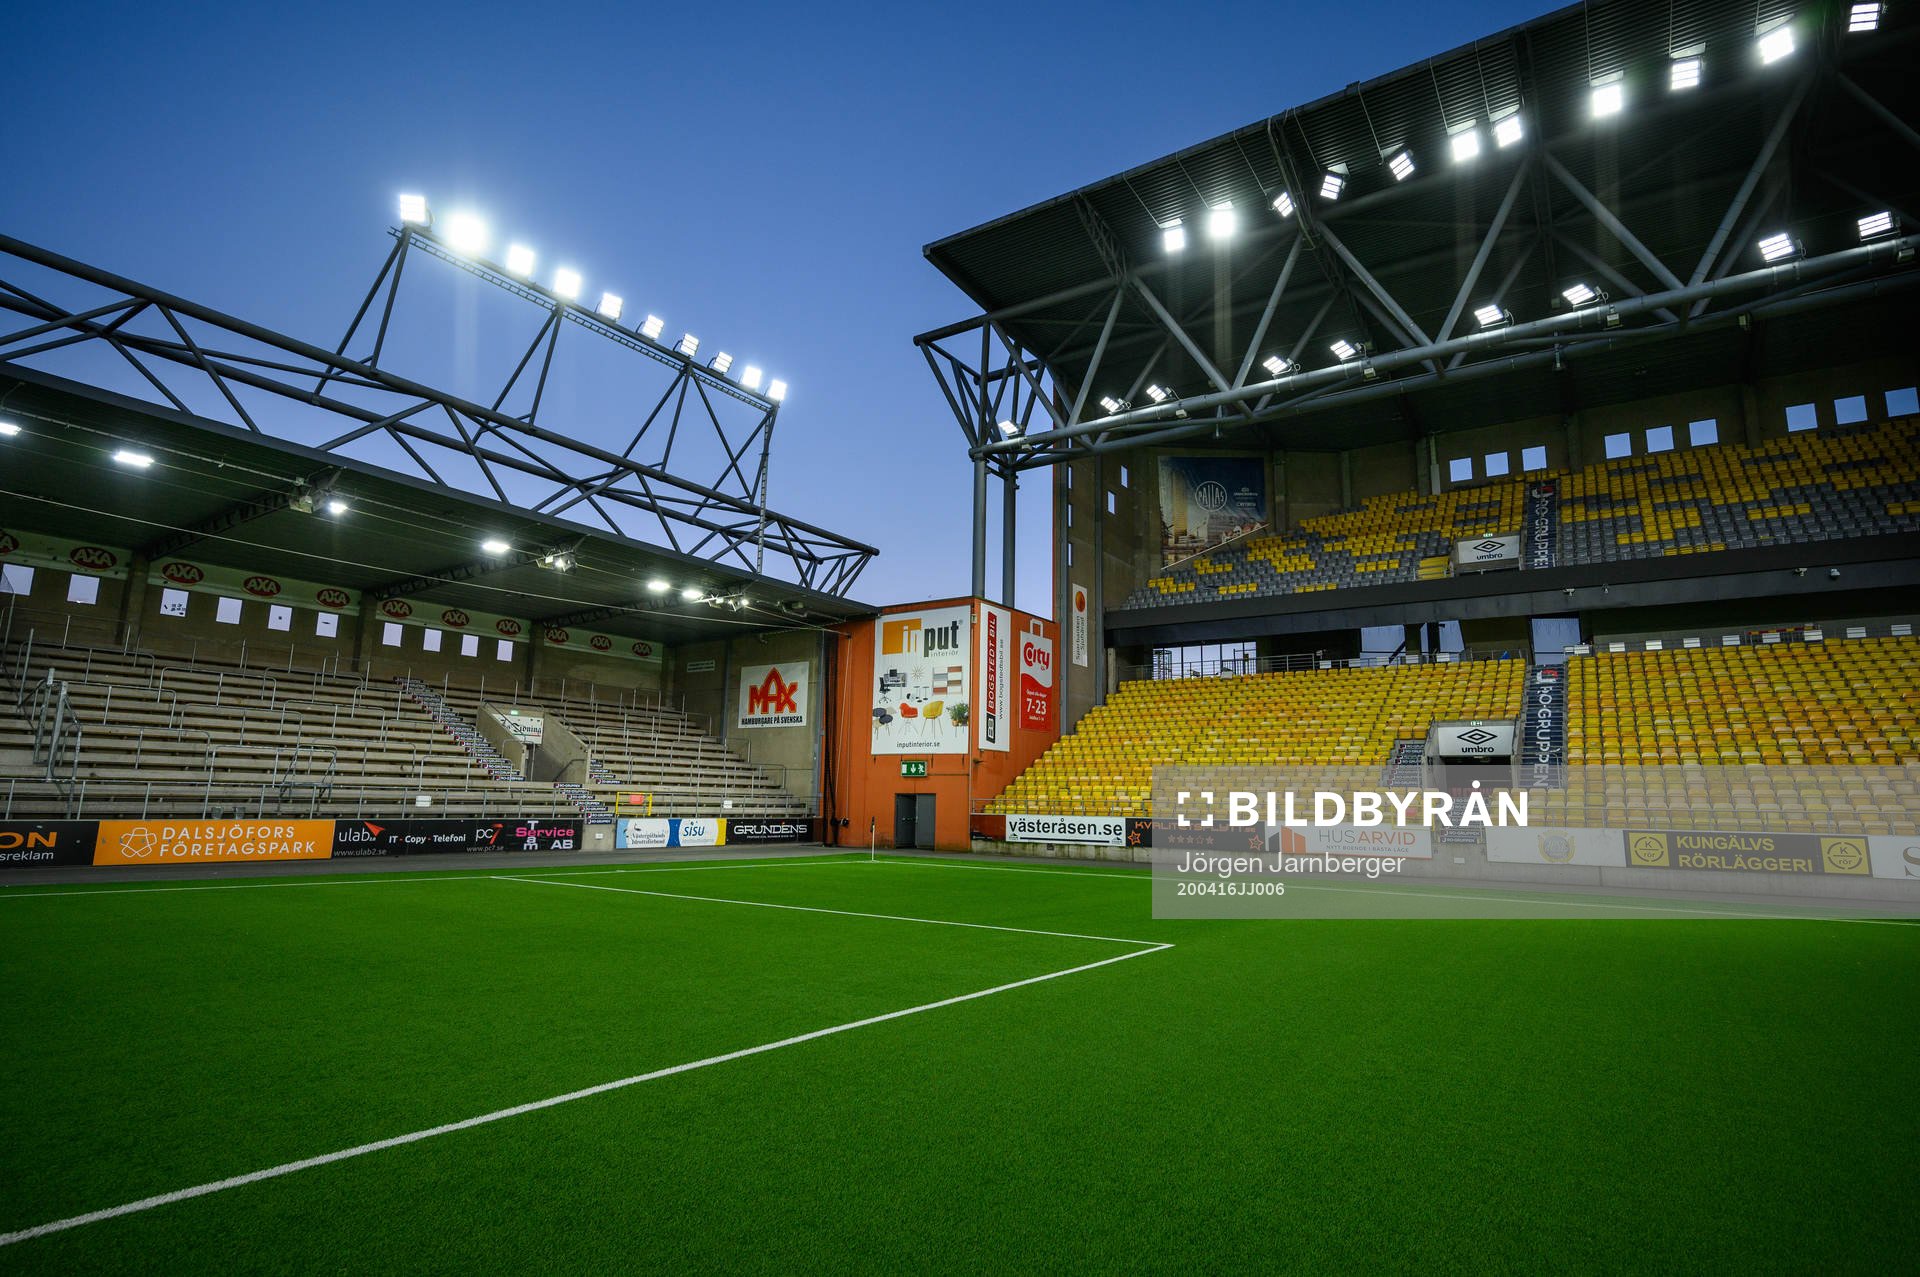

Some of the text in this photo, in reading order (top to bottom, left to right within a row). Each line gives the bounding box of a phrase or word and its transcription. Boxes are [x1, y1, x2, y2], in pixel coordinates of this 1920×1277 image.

[1198, 484, 1224, 509] PALLAS
[74, 548, 113, 567] AXA
[1476, 552, 1503, 561] umbro
[167, 563, 200, 582] AXA
[247, 576, 278, 594] AXA
[319, 588, 348, 605] AXA
[386, 600, 411, 614] AXA
[443, 609, 468, 625] AXA
[498, 620, 520, 633] AXA
[548, 629, 568, 642] AXA
[592, 635, 611, 648] AXA
[902, 620, 959, 658] input
[633, 643, 650, 655] AXA
[930, 650, 959, 658] interior
[1023, 641, 1050, 670] City
[748, 667, 799, 715] MAX
[1026, 698, 1047, 715] 7-23
[741, 716, 803, 725] HAMBURGARE PÅ SVENSKA
[896, 741, 941, 749] inputinterior.se
[1461, 745, 1495, 753] umbro
[161, 824, 296, 840] DALSJÖFORS
[475, 823, 504, 845] pc7
[515, 827, 575, 838] Service
[1009, 818, 1123, 835] västeråsen.se
[389, 836, 398, 844] IT
[405, 835, 427, 845] Copy
[433, 834, 466, 843] Telefoni
[550, 839, 574, 850] AB
[1676, 835, 1775, 851] KUNGÄLVS
[159, 841, 316, 857] FÖRETAGSPARK
[333, 849, 387, 857] www.ulab2.se
[466, 845, 504, 853] www.pc7.se
[1678, 853, 1813, 873] RÖRLÄGGERI
